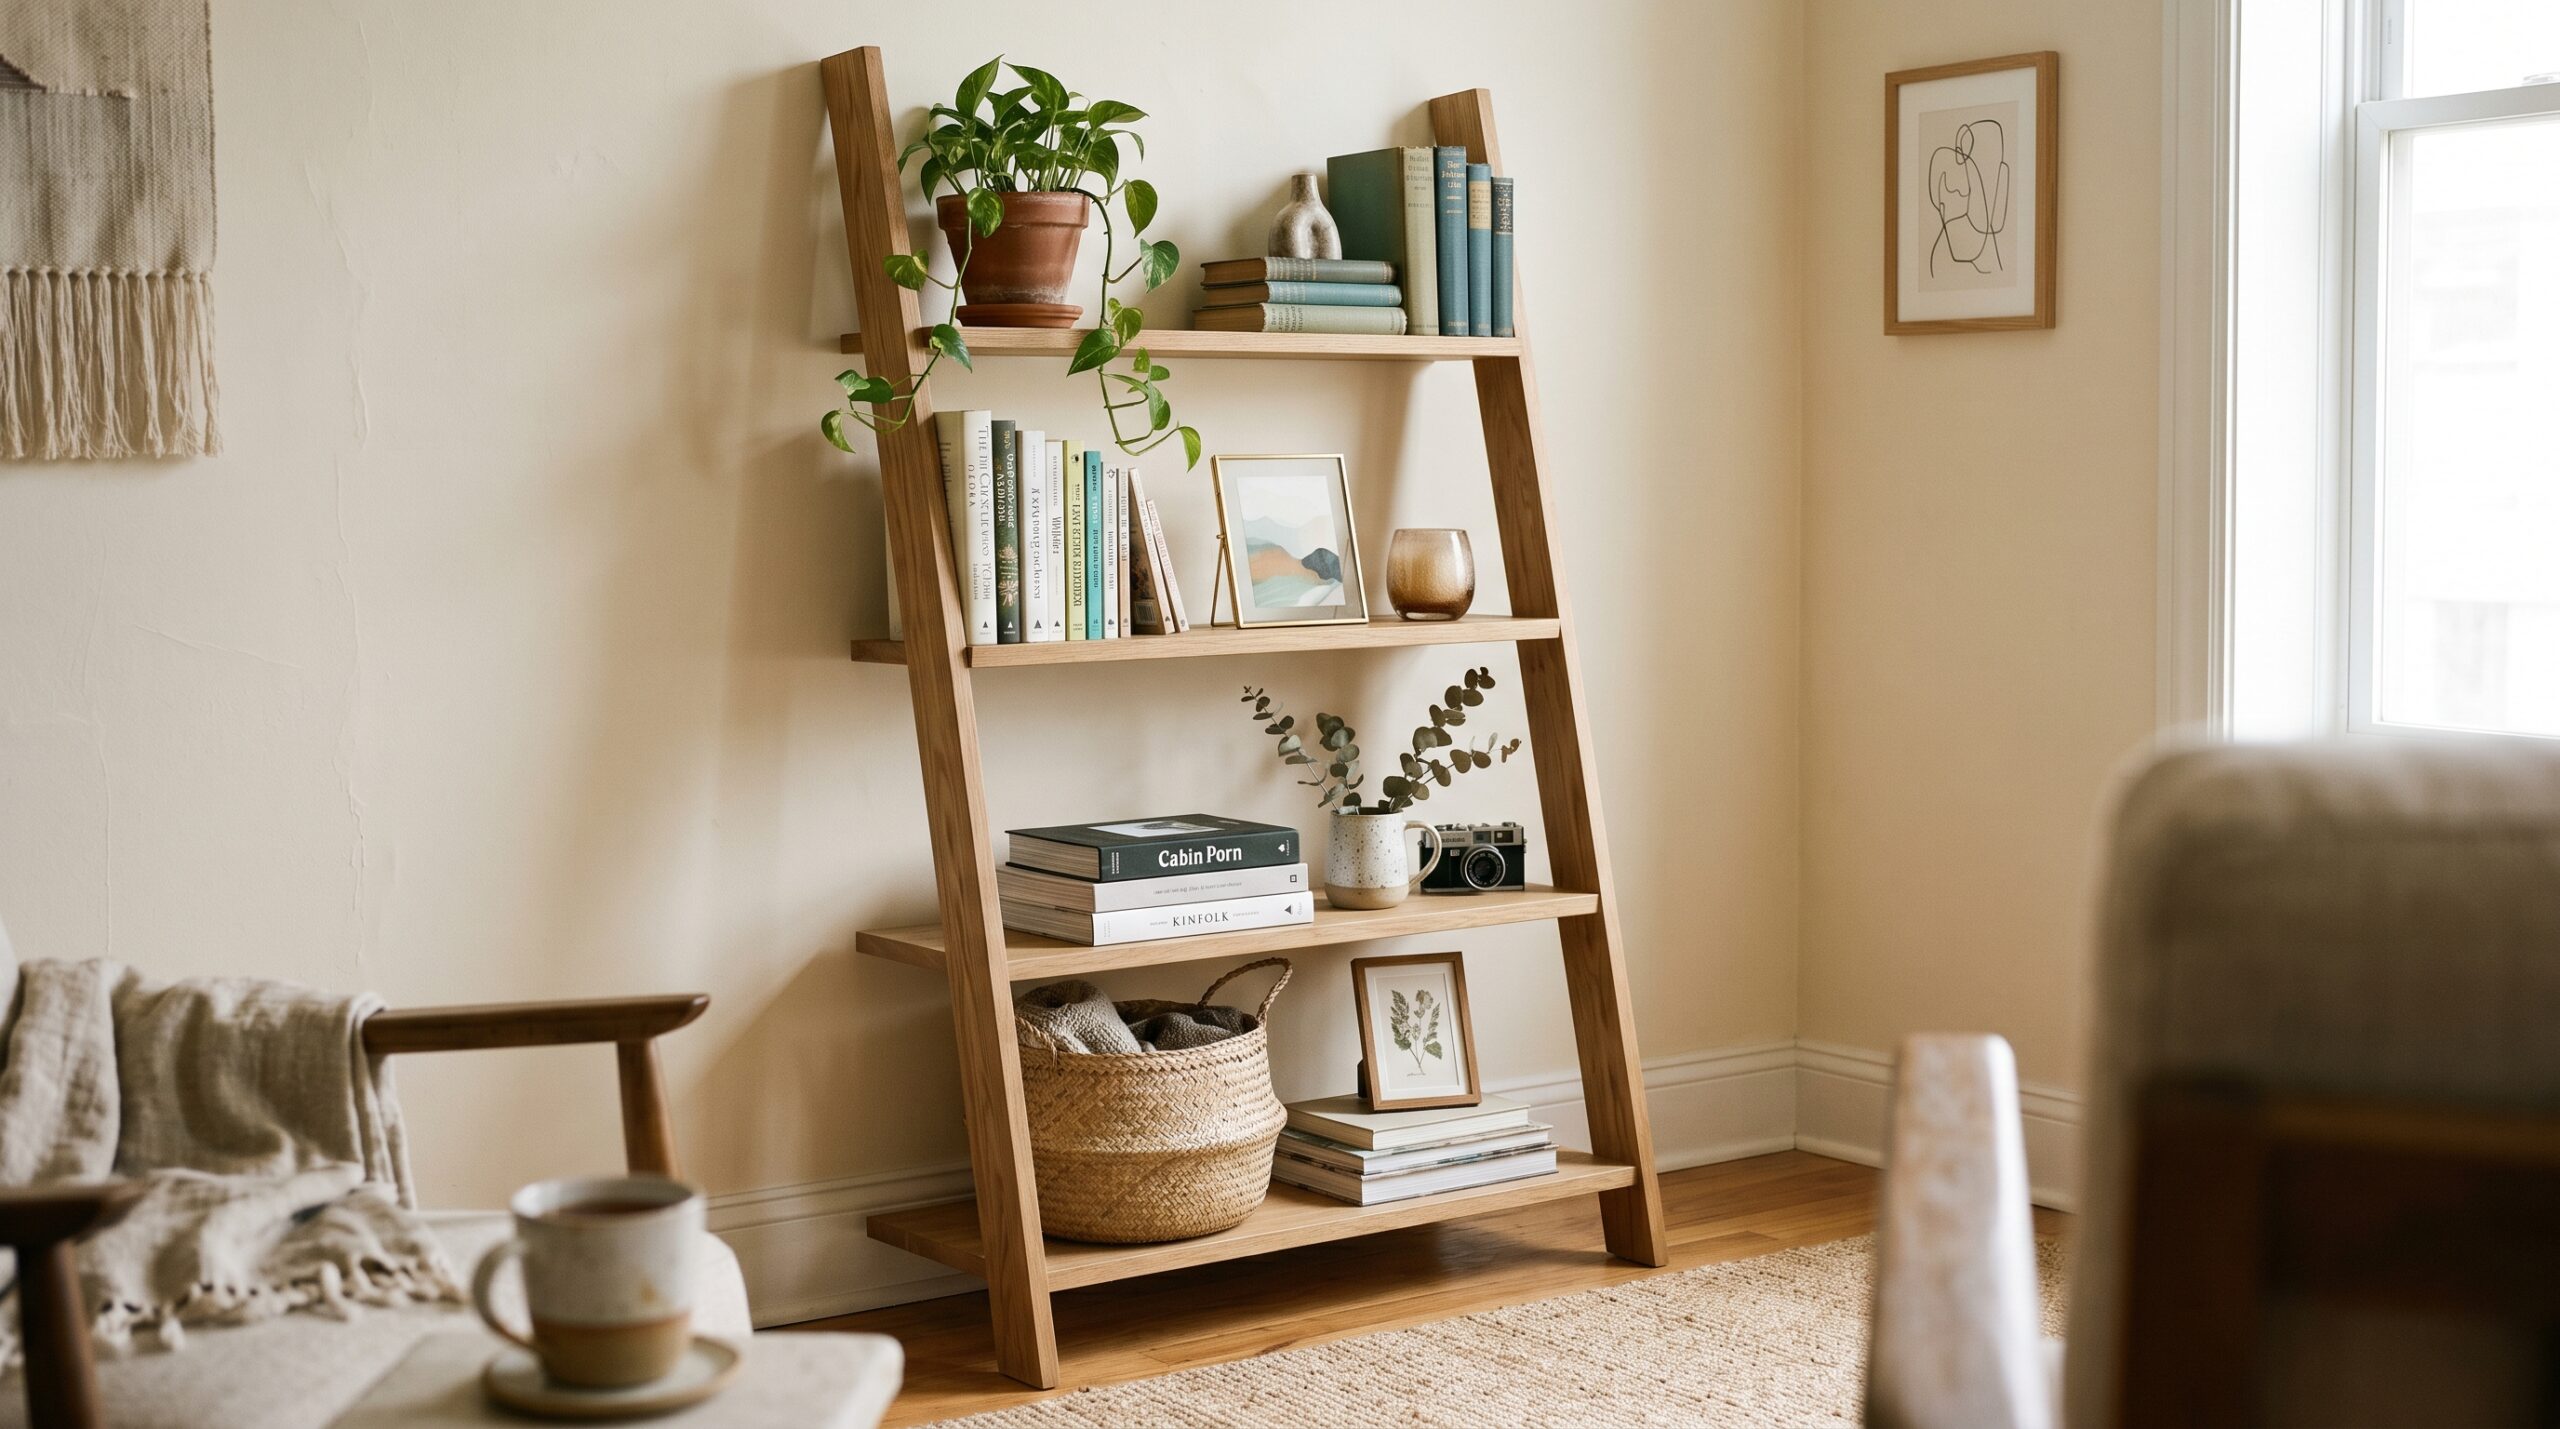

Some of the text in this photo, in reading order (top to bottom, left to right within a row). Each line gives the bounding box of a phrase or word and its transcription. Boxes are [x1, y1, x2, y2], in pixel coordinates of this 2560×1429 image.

[1158, 845, 1242, 868] Cabin Porn
[1172, 911, 1229, 927] KINFOLK
